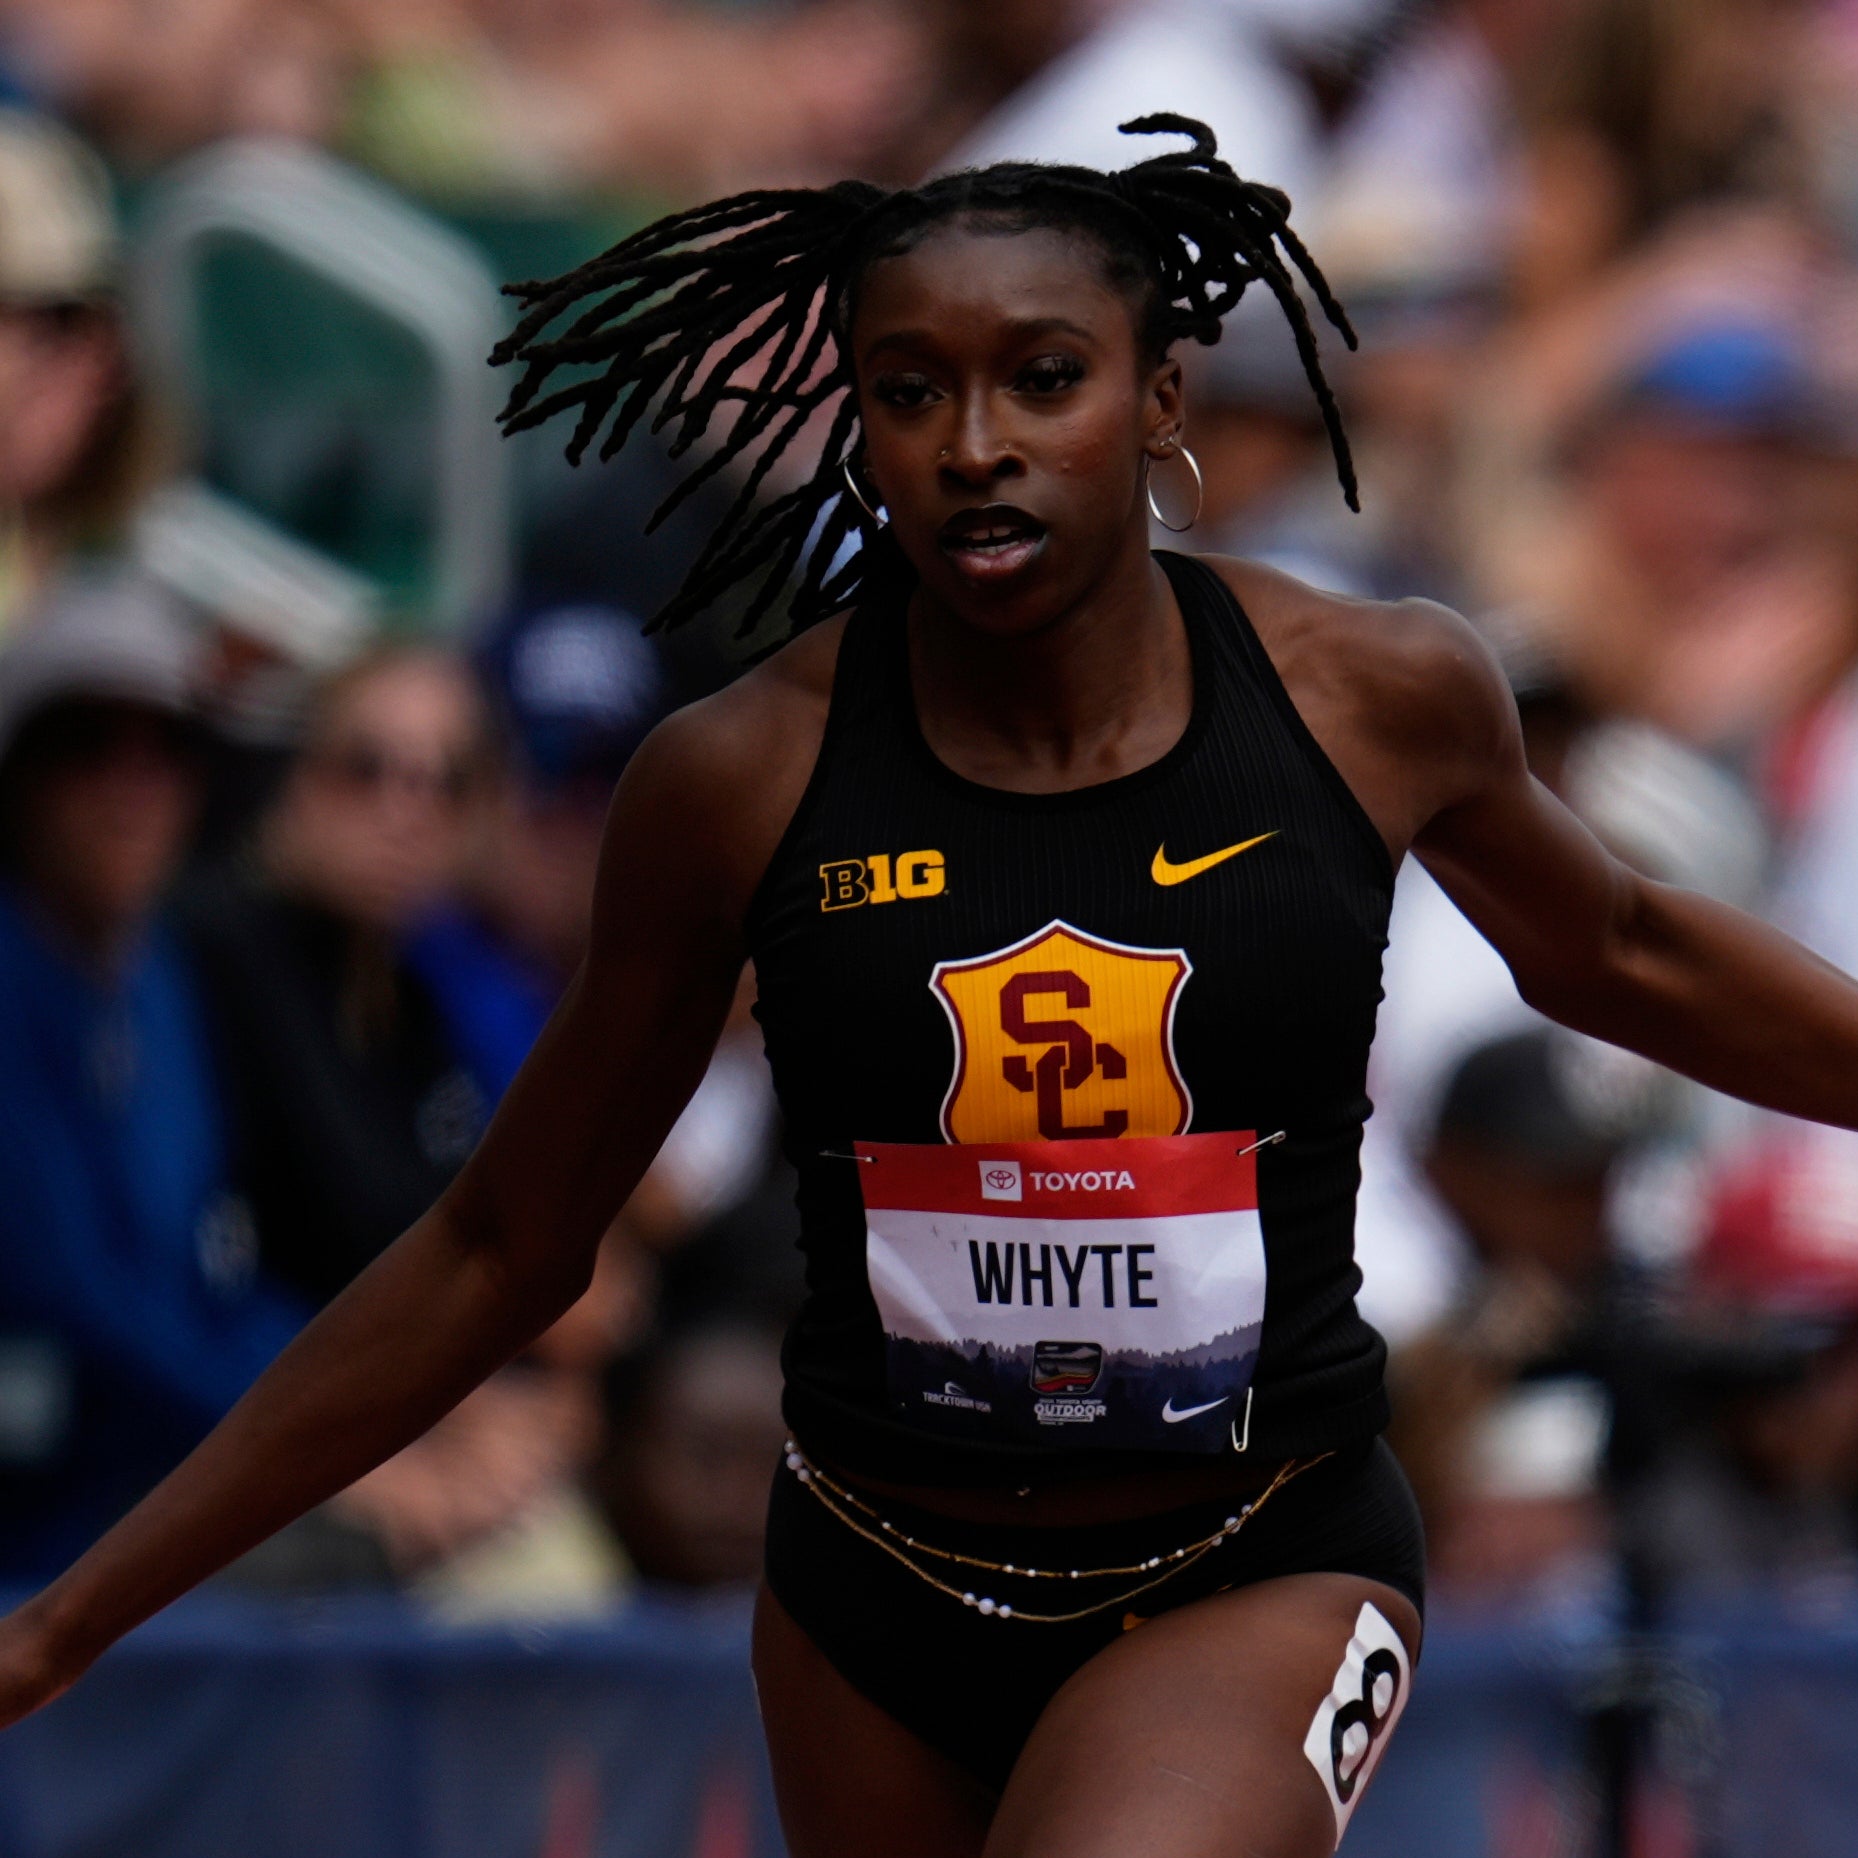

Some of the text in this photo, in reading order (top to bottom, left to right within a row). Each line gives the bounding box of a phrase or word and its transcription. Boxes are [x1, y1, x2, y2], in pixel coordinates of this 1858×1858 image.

[1029, 1170, 1136, 1192] TOYOTA
[968, 1239, 1159, 1309] WHYTE
[1034, 1403, 1106, 1417] OUTDOOR
[1330, 1647, 1402, 1805] 8
